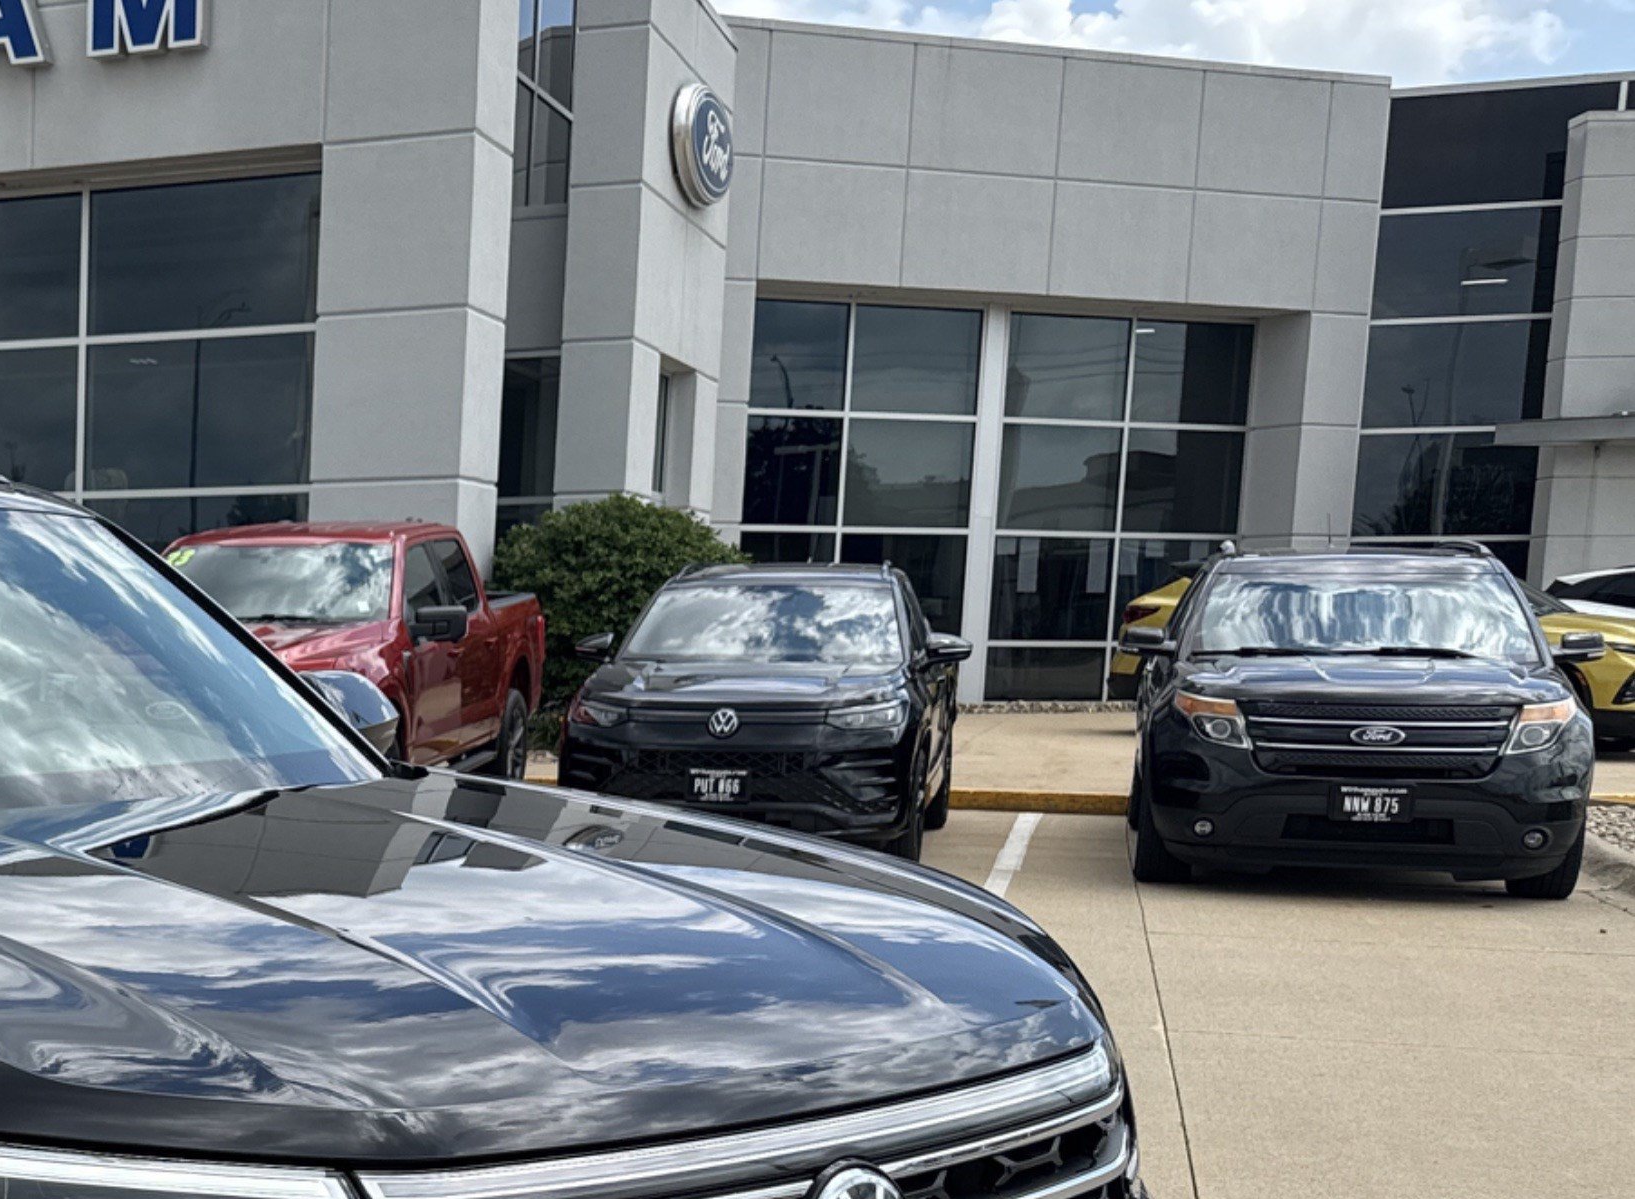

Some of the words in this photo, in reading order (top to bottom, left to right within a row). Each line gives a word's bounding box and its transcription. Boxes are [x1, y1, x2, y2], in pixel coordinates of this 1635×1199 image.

[702, 109, 731, 183] Ford
[694, 777, 715, 793] PUT
[1343, 796, 1371, 812] NNW
[1373, 796, 1400, 815] 875
